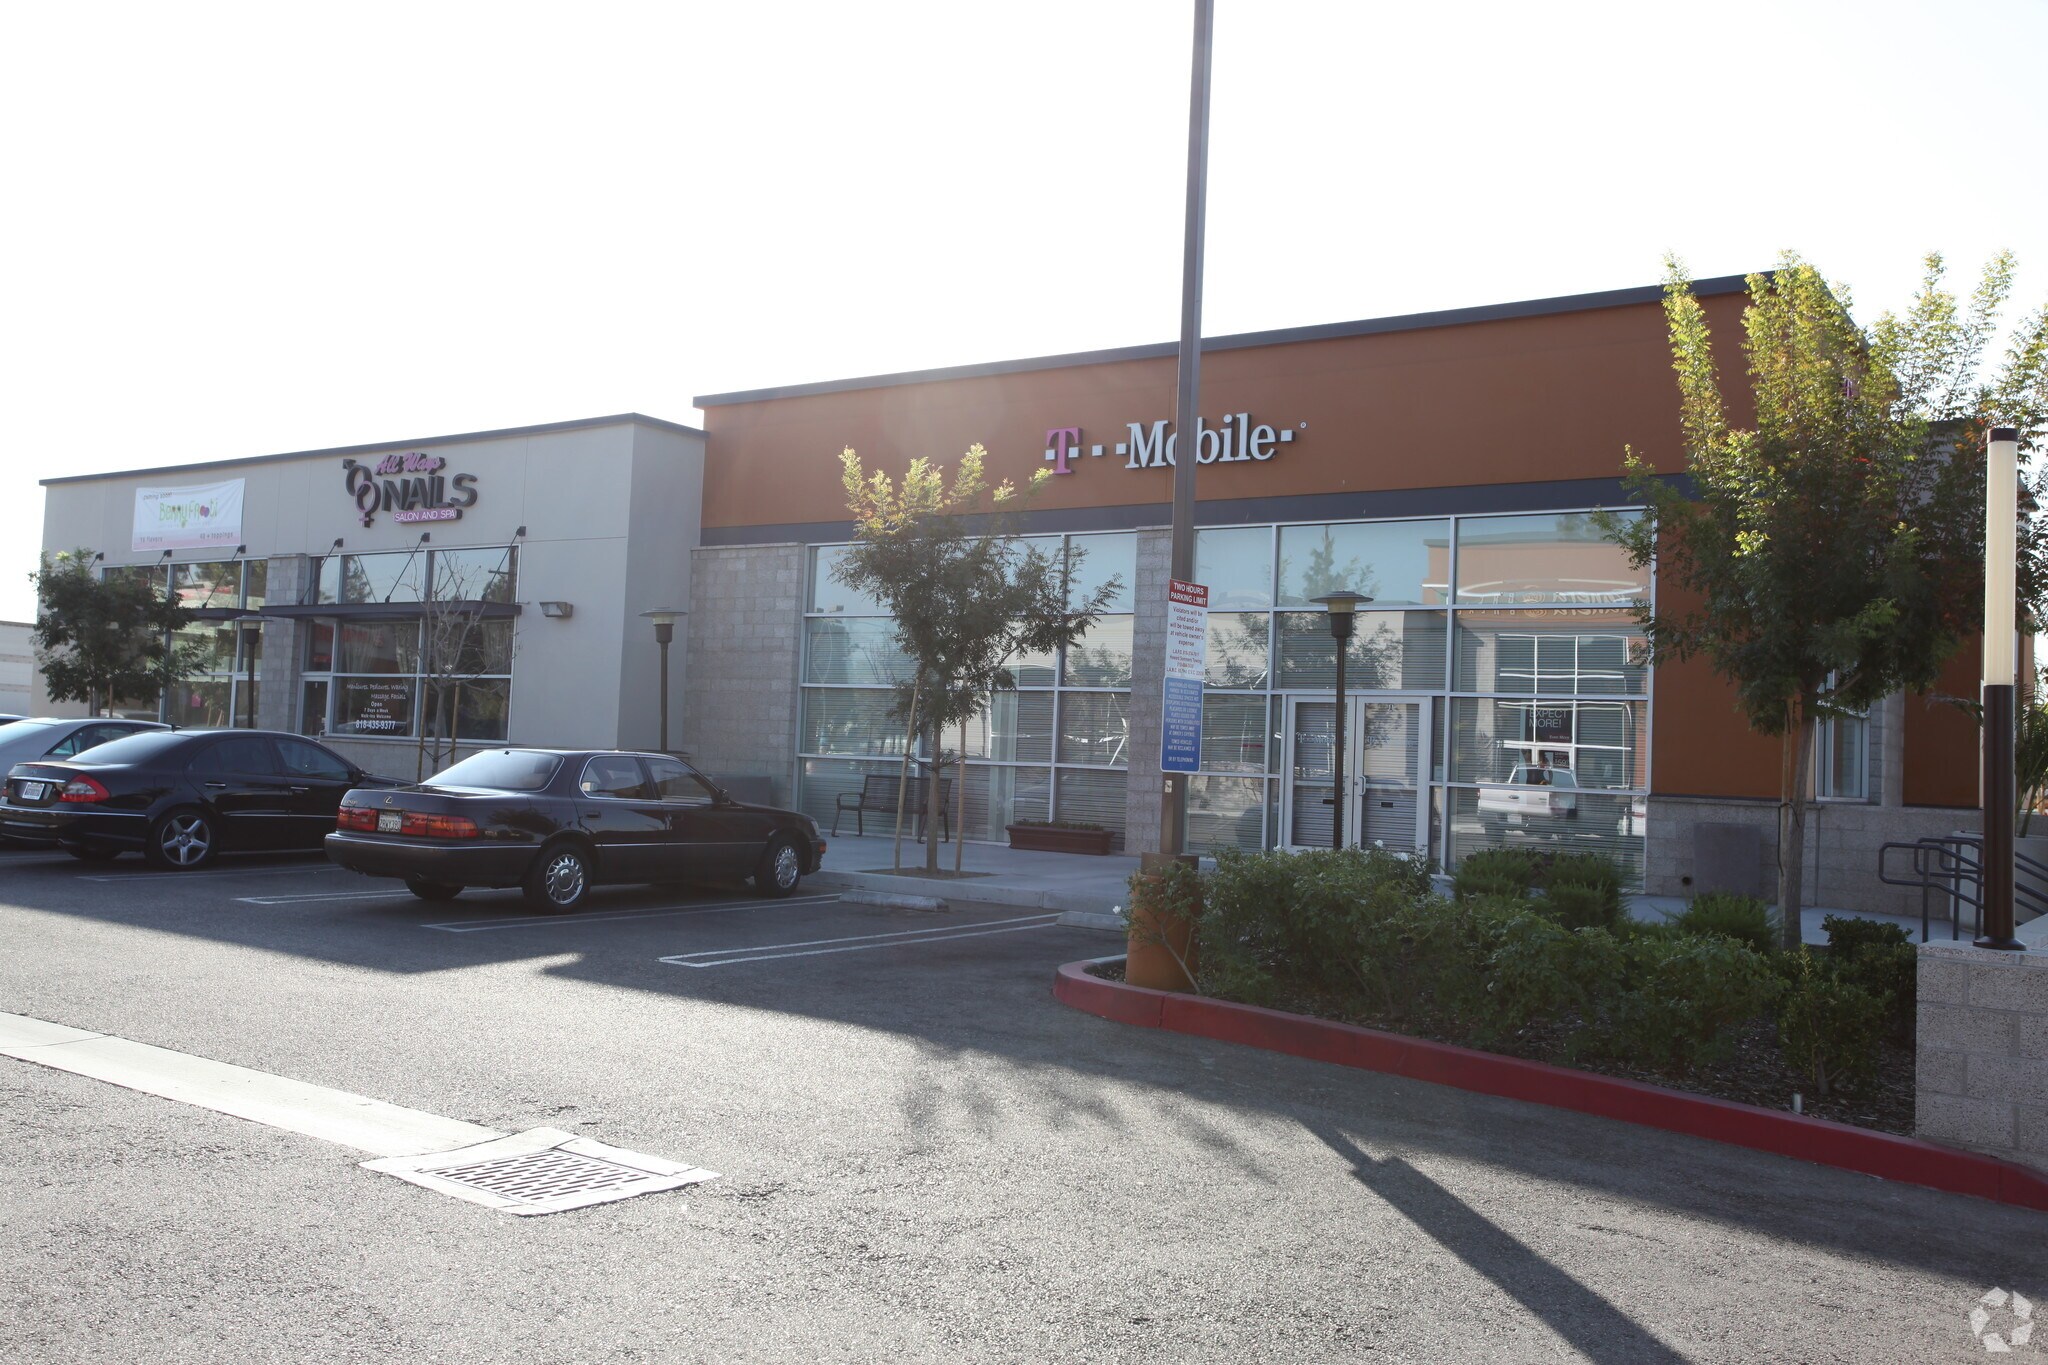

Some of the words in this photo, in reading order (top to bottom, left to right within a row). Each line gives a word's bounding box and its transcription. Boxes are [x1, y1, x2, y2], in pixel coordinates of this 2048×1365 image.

[375, 454, 402, 475] All
[403, 452, 443, 475] Ways
[382, 473, 478, 512] NAILS
[395, 511, 419, 522] SALON
[421, 511, 438, 520] AND
[440, 509, 456, 519] SPA
[1173, 582, 1186, 591] TWO
[1185, 585, 1204, 595] HOURS
[1170, 592, 1192, 603] PARKING
[1193, 596, 1206, 605] LIMIT
[1173, 606, 1189, 614] Violators
[1529, 708, 1568, 719] EXPECT
[355, 720, 396, 730] 818-435-9377
[1528, 718, 1562, 728] MORE!
